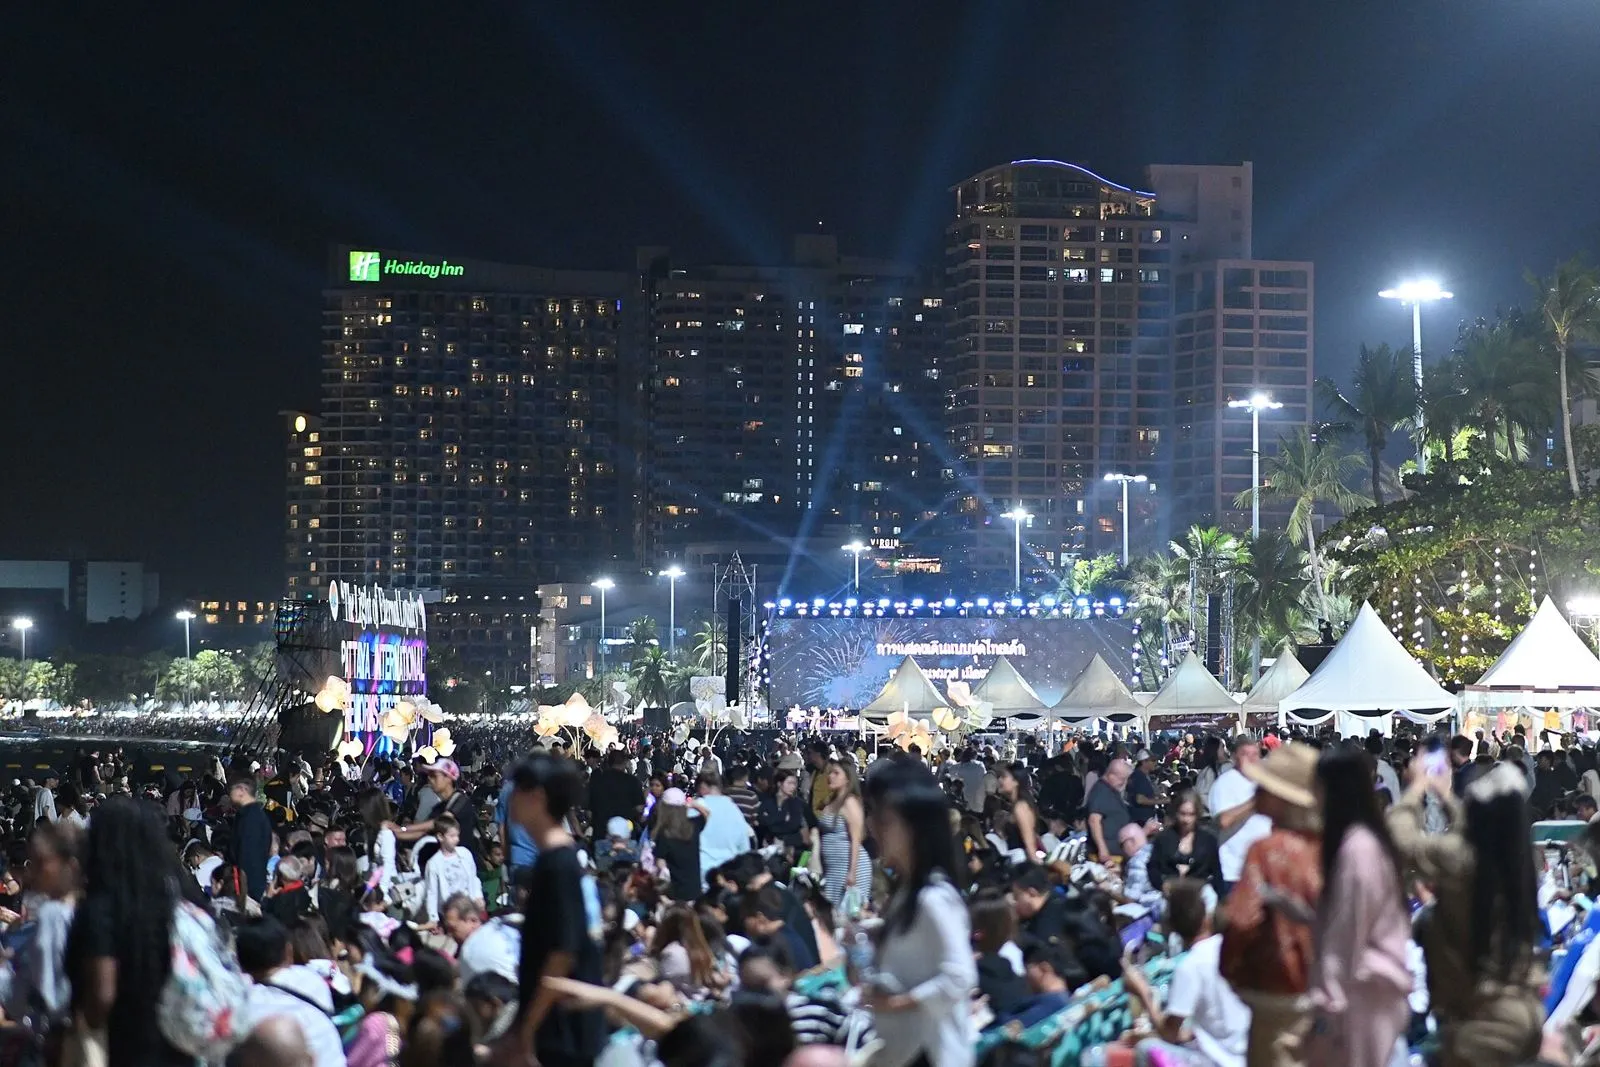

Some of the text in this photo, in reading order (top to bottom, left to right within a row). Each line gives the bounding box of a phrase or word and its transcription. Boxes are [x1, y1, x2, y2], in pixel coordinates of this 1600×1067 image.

[384, 259, 464, 279] Holiday Inn
[870, 538, 900, 547] VIRGIN
